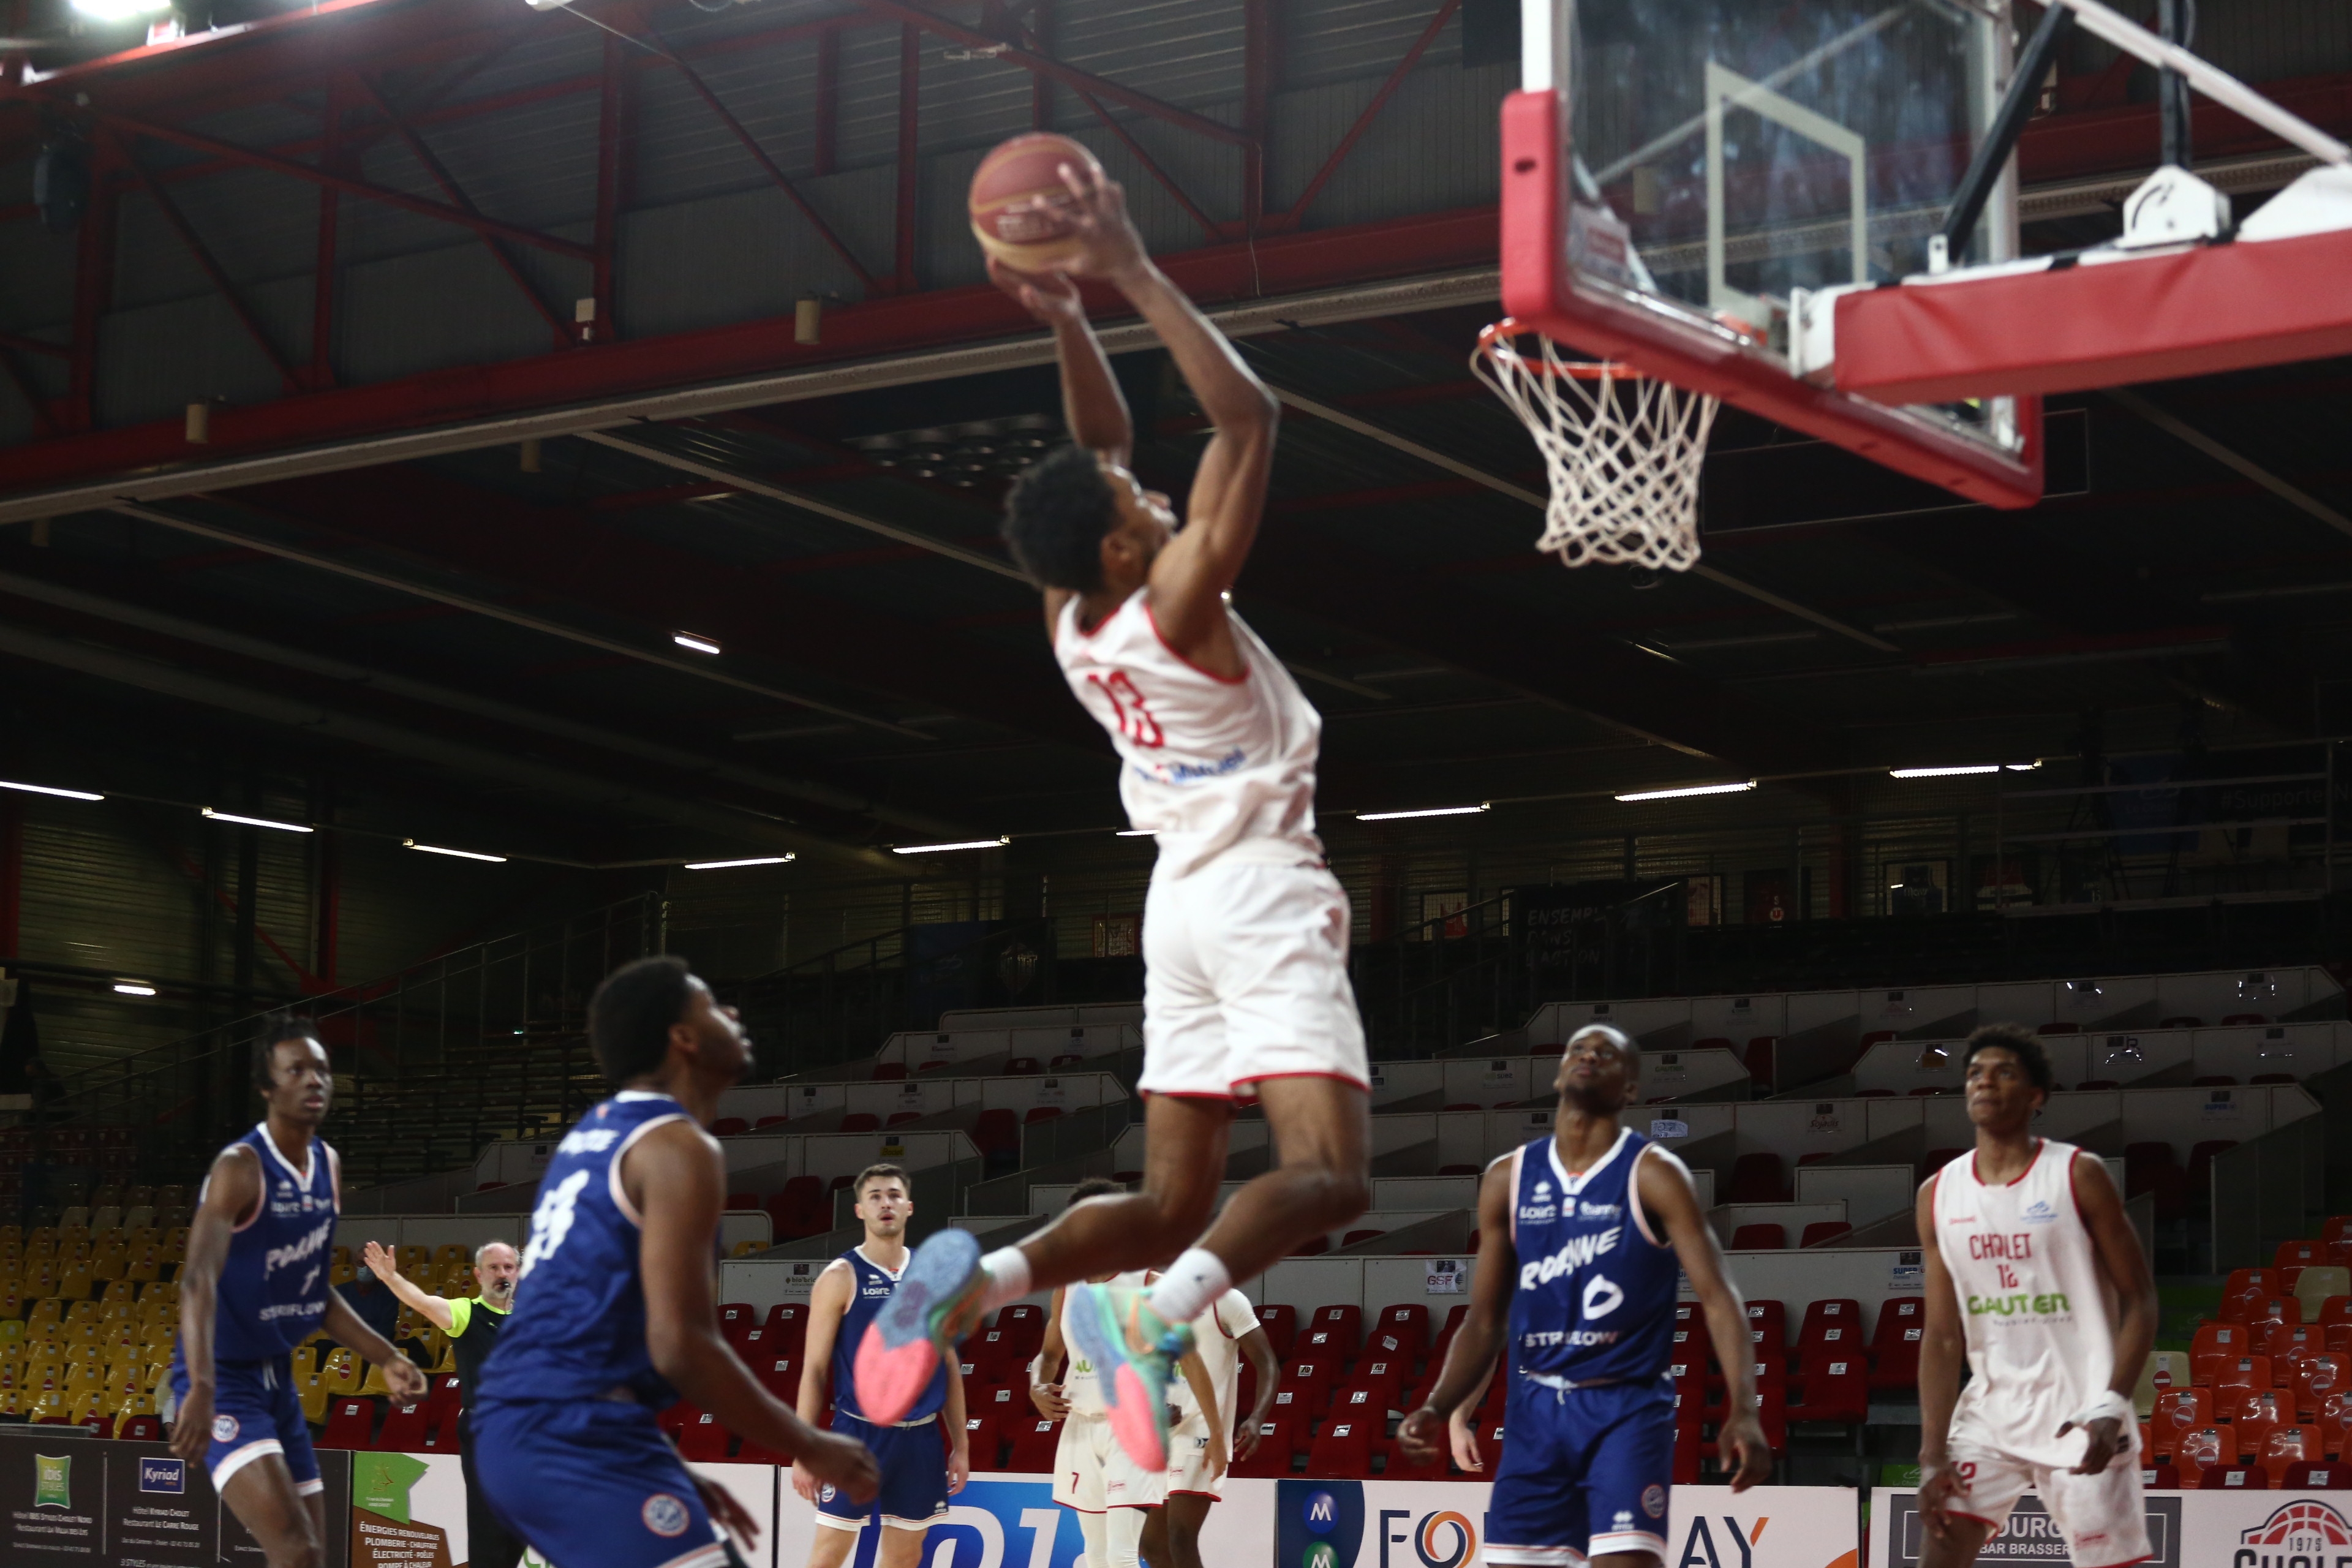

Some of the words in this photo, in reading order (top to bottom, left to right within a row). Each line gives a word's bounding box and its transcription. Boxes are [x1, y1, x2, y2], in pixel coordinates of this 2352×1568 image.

[1427, 1275, 1453, 1286] GSF
[144, 1468, 179, 1483] Kyriad
[1072, 1471, 1079, 1494] 7
[360, 1521, 398, 1536] ÉNERGIES
[398, 1529, 440, 1541] RENOUVELABLES
[365, 1537, 407, 1548] PLOMBERIE
[410, 1541, 438, 1550] CHAUFFAGE
[2289, 1537, 2322, 1551] 1975
[373, 1548, 413, 1559] ÉLECTRICITÉ
